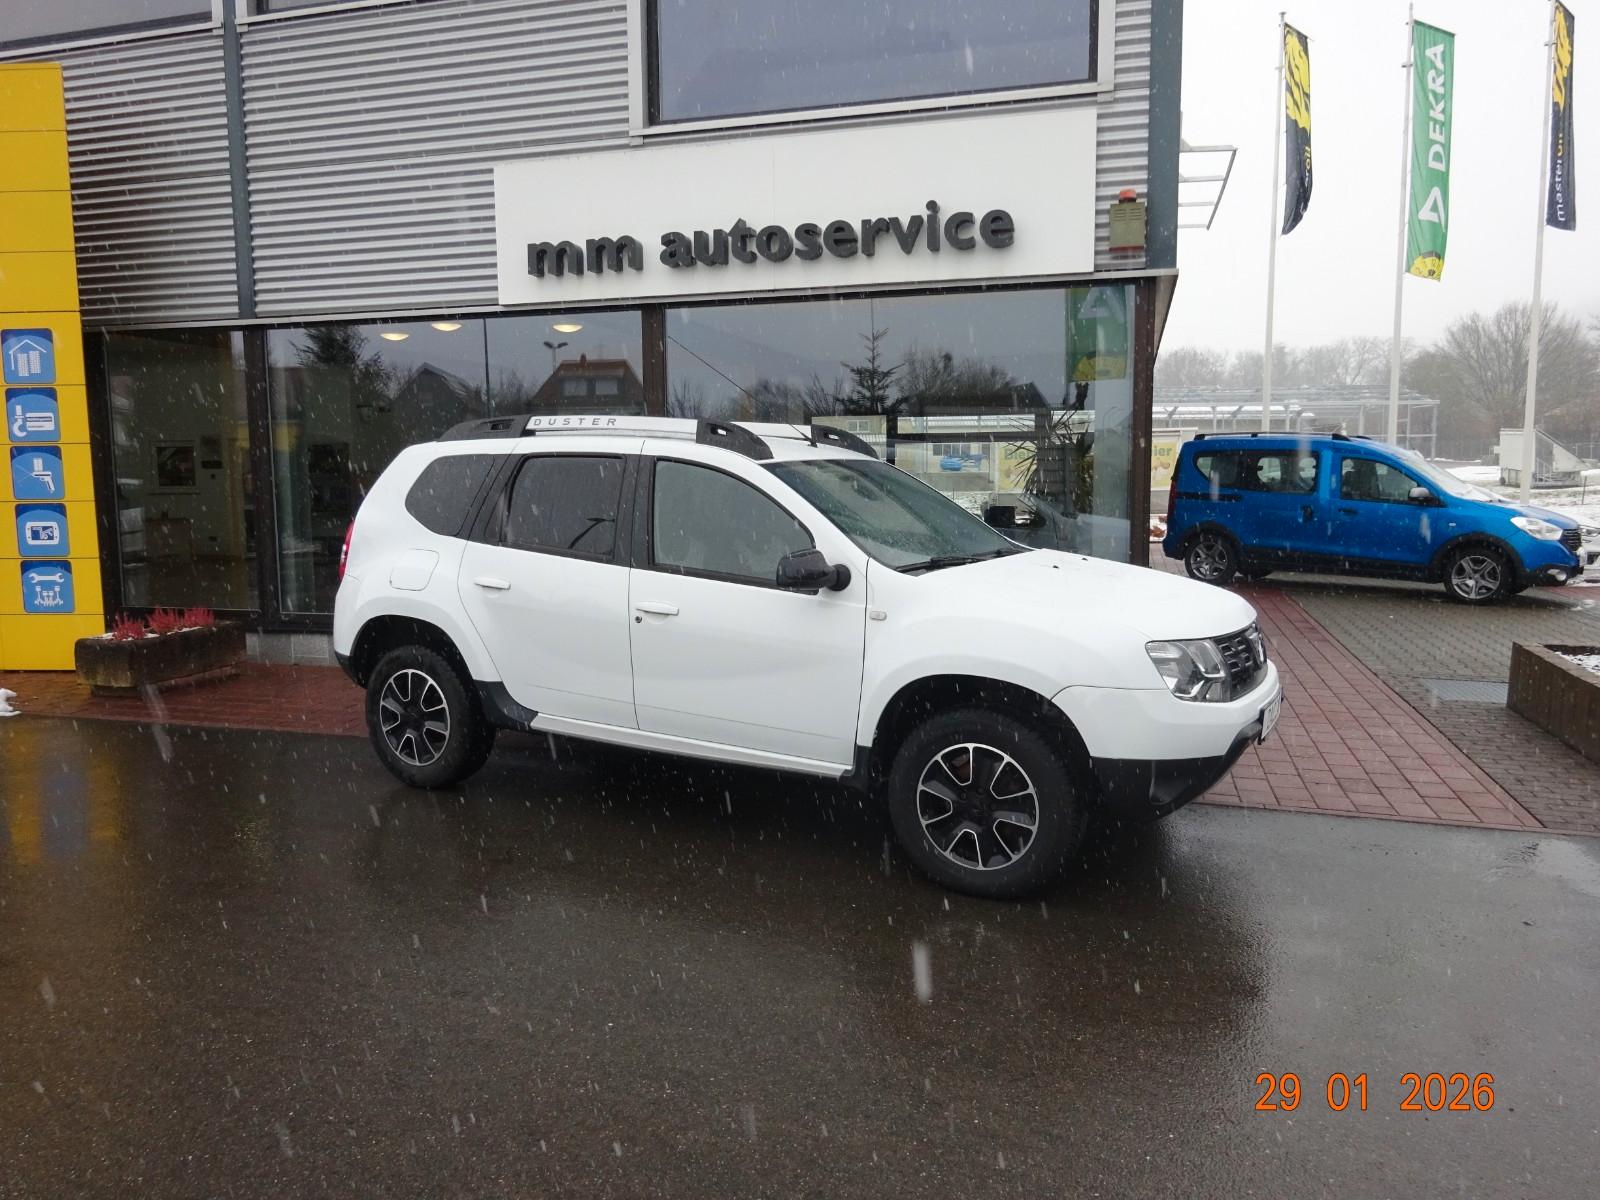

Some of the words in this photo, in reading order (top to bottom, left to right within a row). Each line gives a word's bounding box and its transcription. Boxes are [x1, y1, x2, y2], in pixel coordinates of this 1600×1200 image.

[1426, 43, 1446, 172] DEKRA
[527, 235, 644, 278] mm
[659, 200, 1015, 268] autoservice
[533, 417, 617, 426] DUSTER
[1151, 445, 1172, 457] ier
